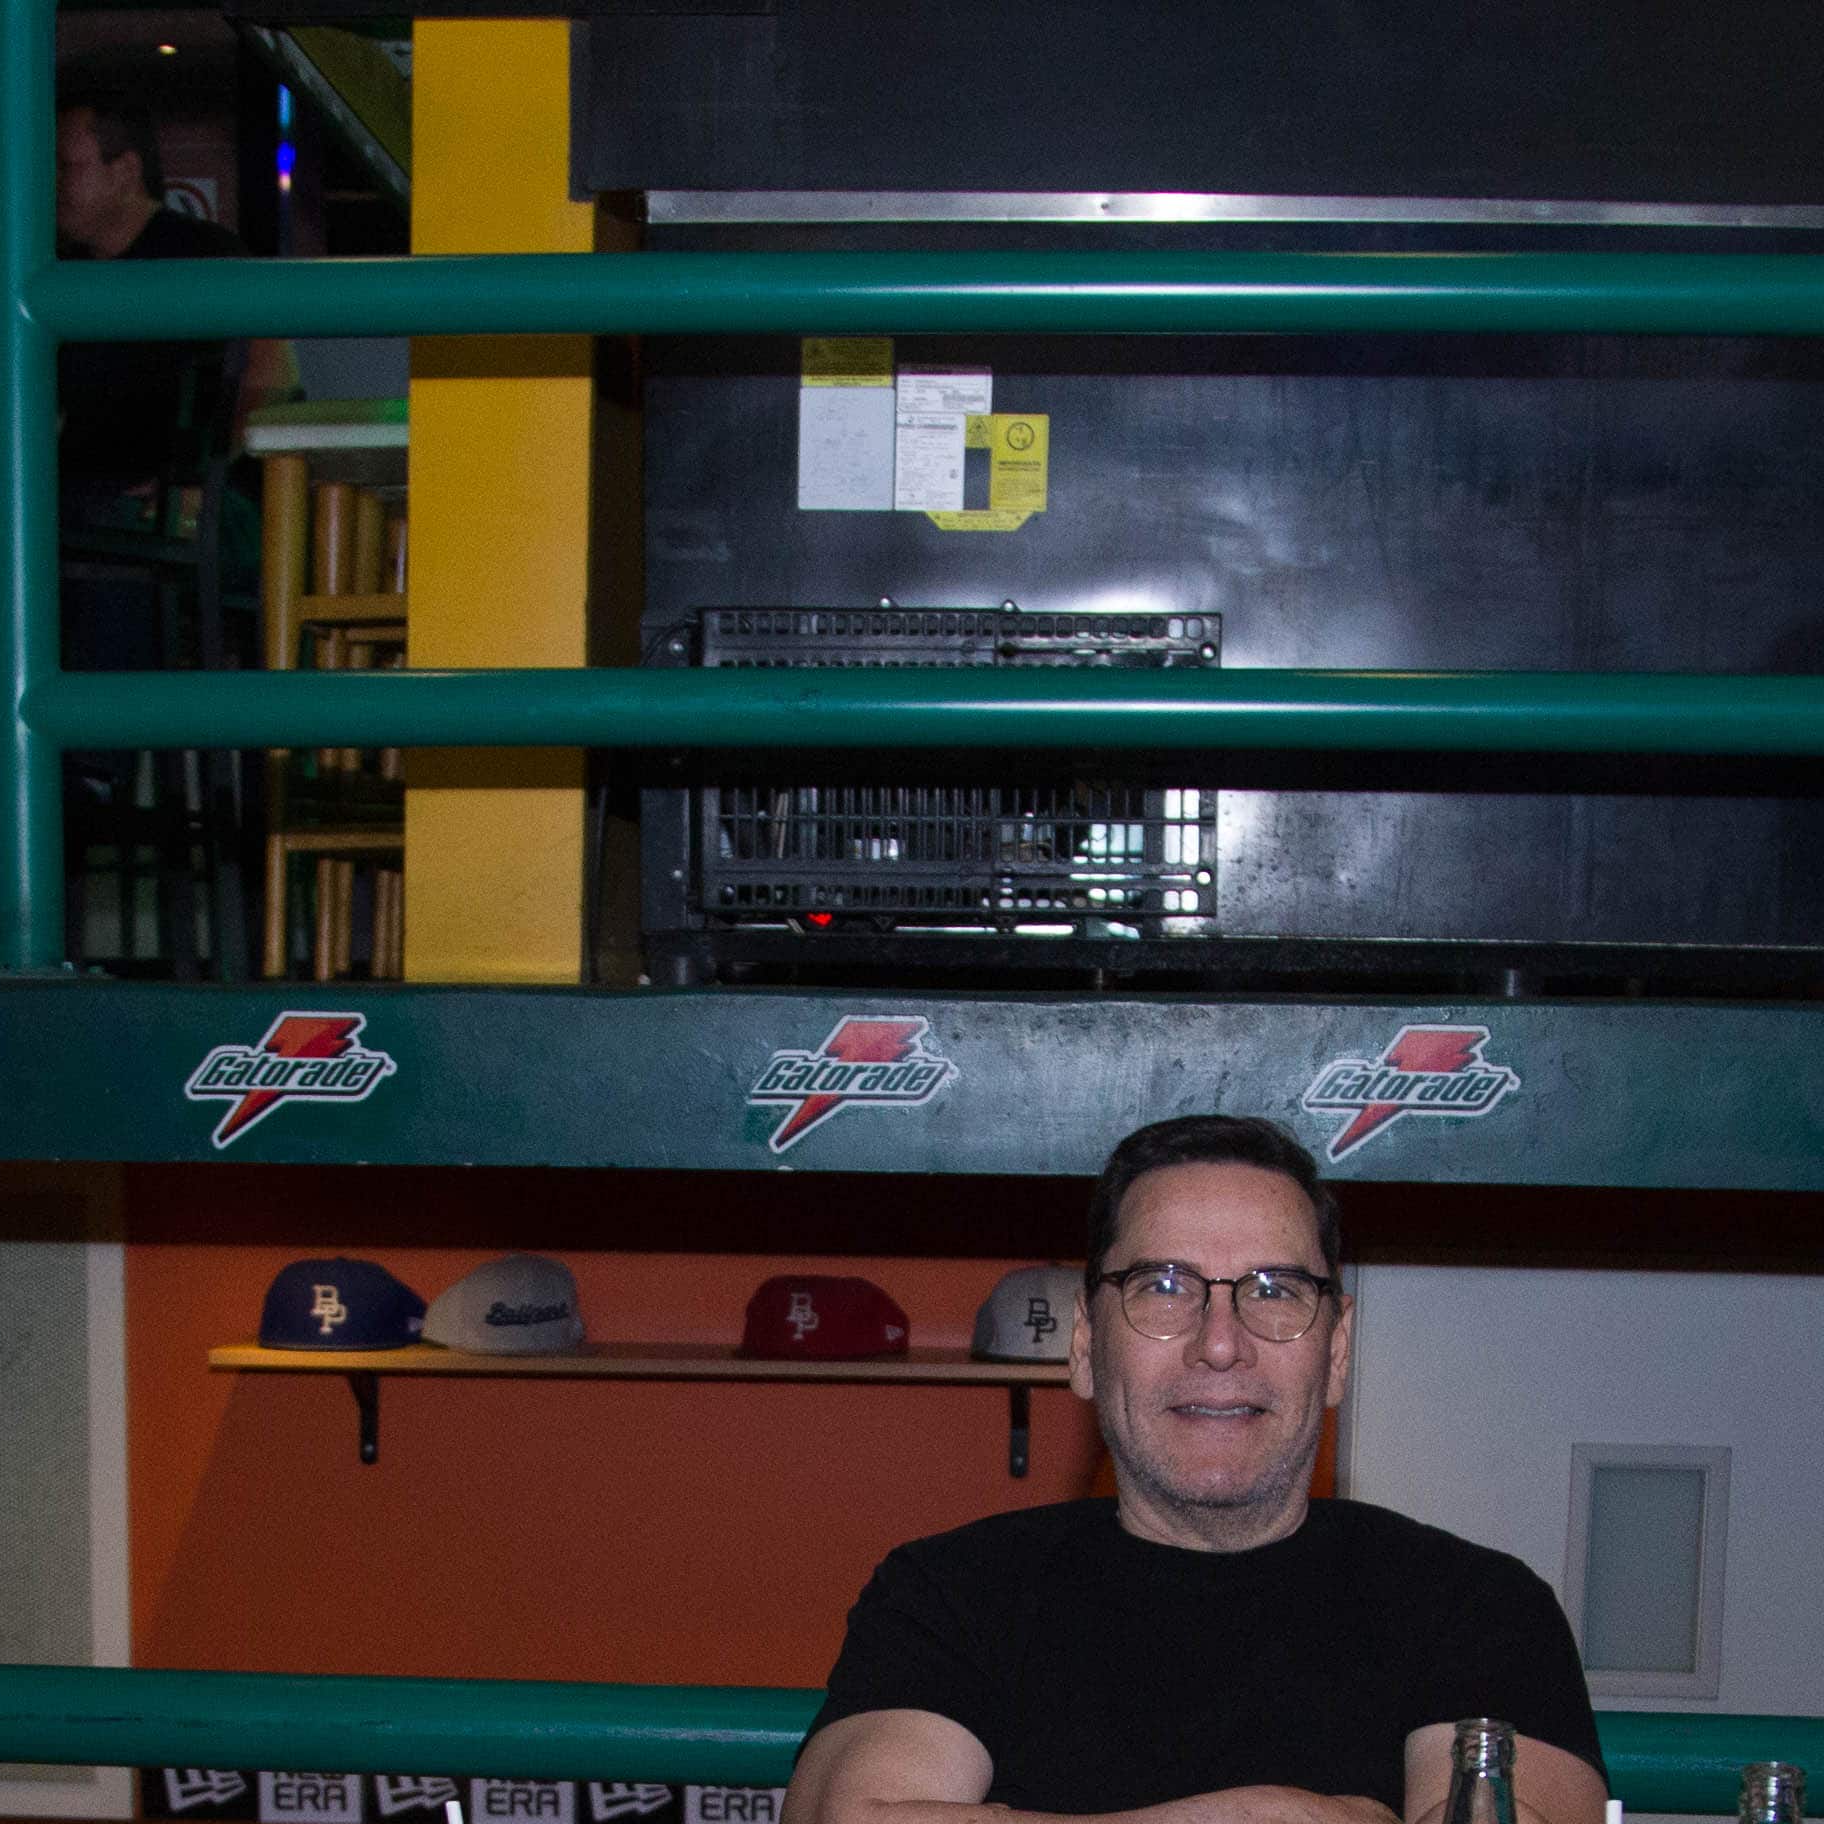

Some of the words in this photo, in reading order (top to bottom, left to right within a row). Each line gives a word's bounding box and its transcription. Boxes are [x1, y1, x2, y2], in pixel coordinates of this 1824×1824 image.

[198, 1054, 379, 1091] Gatorade
[753, 1059, 936, 1096] Gatorade
[1317, 1069, 1505, 1104] Gatorade
[275, 1781, 348, 1812] ERA
[486, 1786, 559, 1816] ERA
[700, 1791, 775, 1821] ERA
